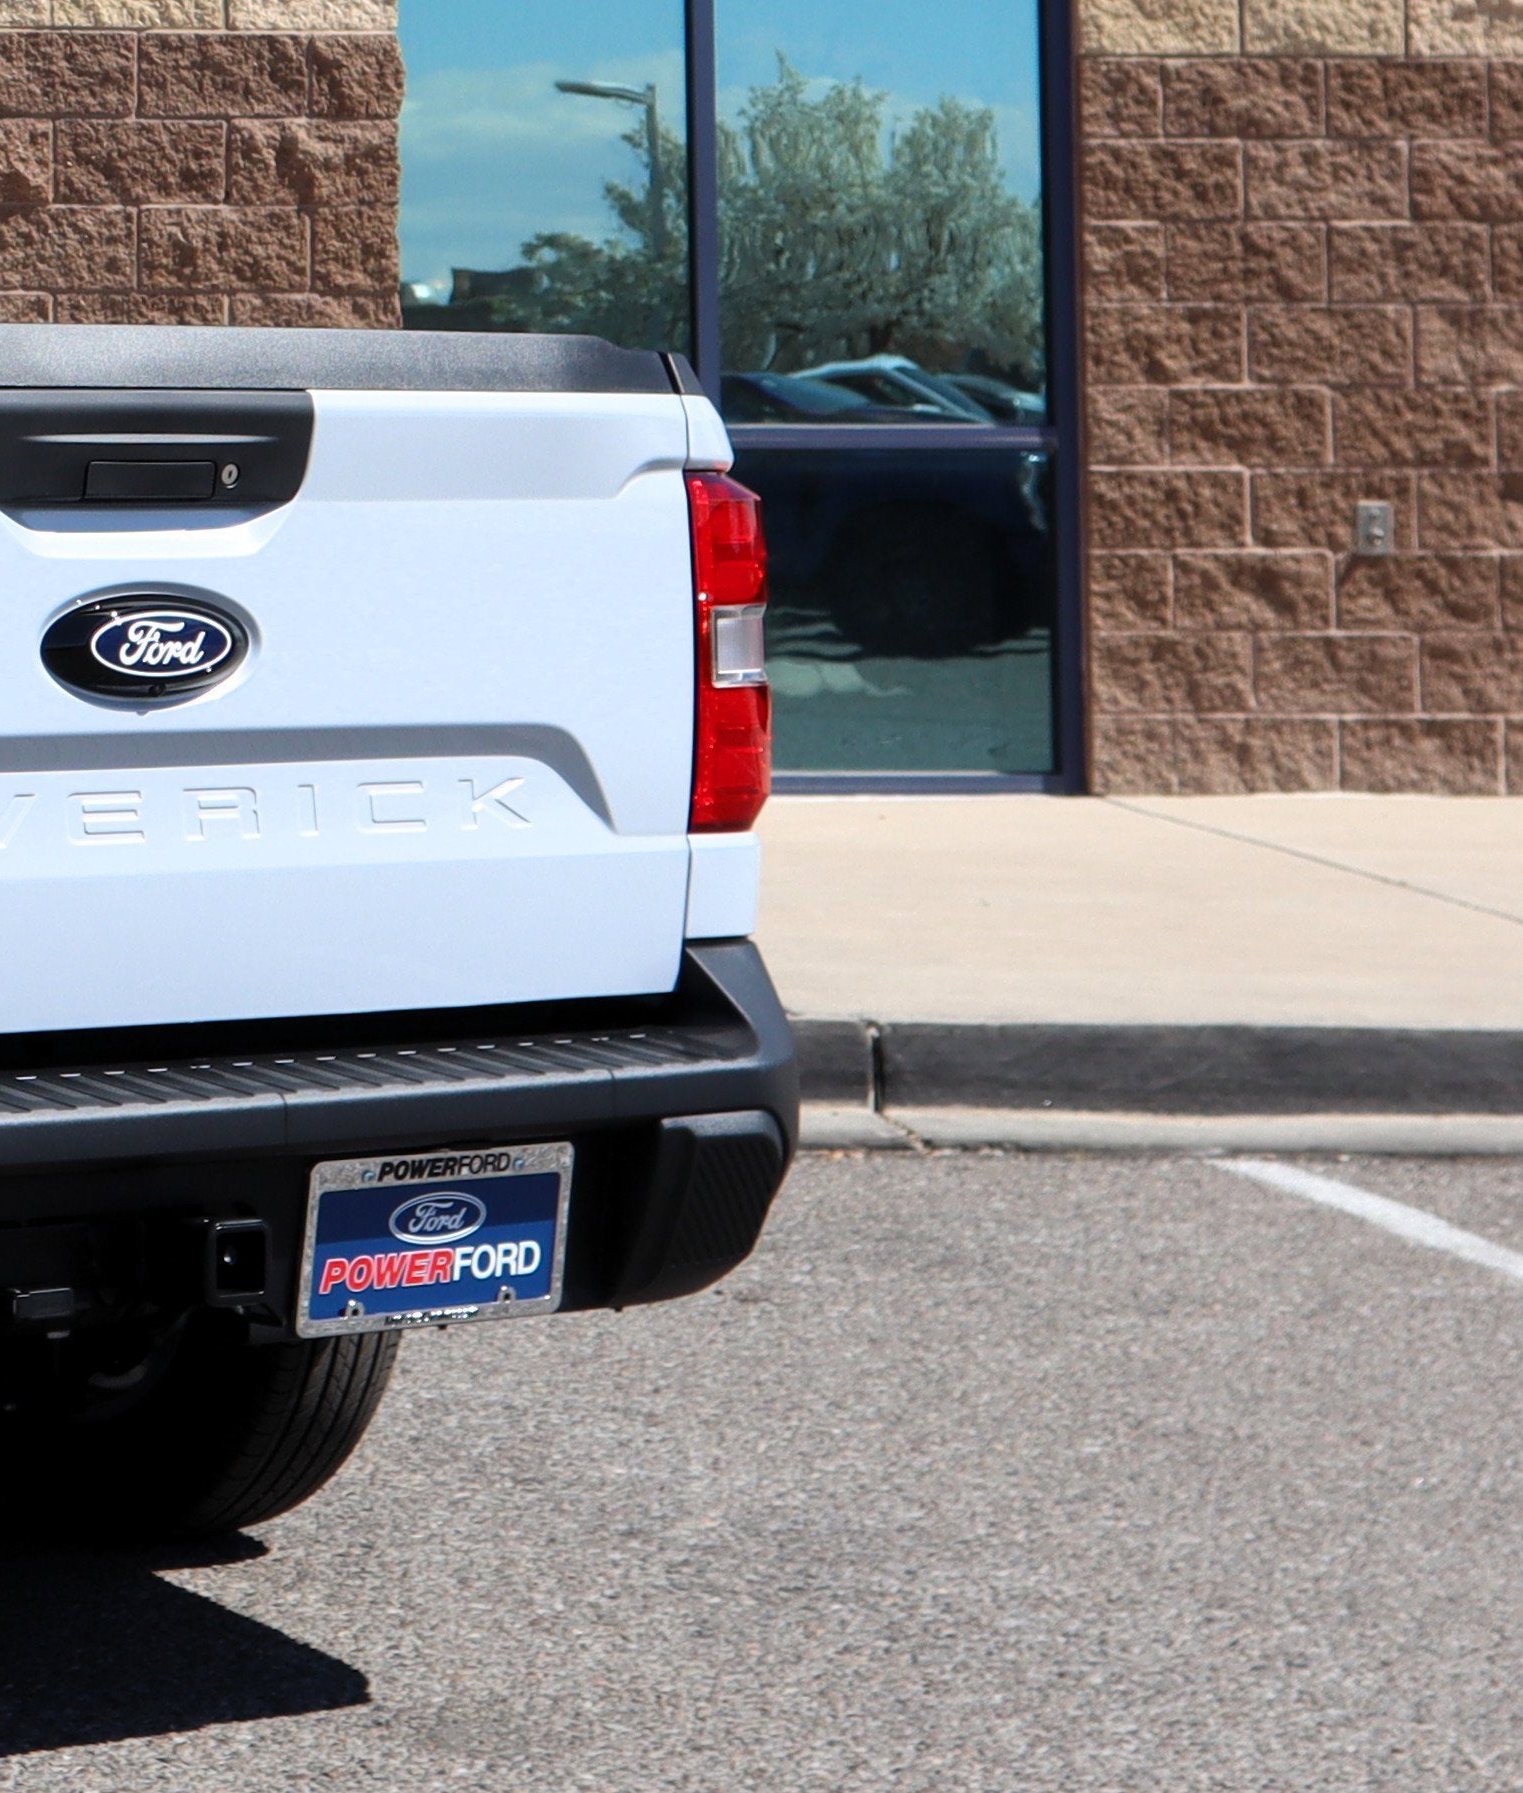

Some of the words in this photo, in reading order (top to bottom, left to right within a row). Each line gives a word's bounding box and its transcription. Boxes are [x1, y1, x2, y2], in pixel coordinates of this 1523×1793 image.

[119, 620, 206, 666] Ford
[377, 1153, 511, 1182] POWERFORD
[408, 1201, 467, 1233] Ford
[319, 1240, 541, 1295] POWERFORD
